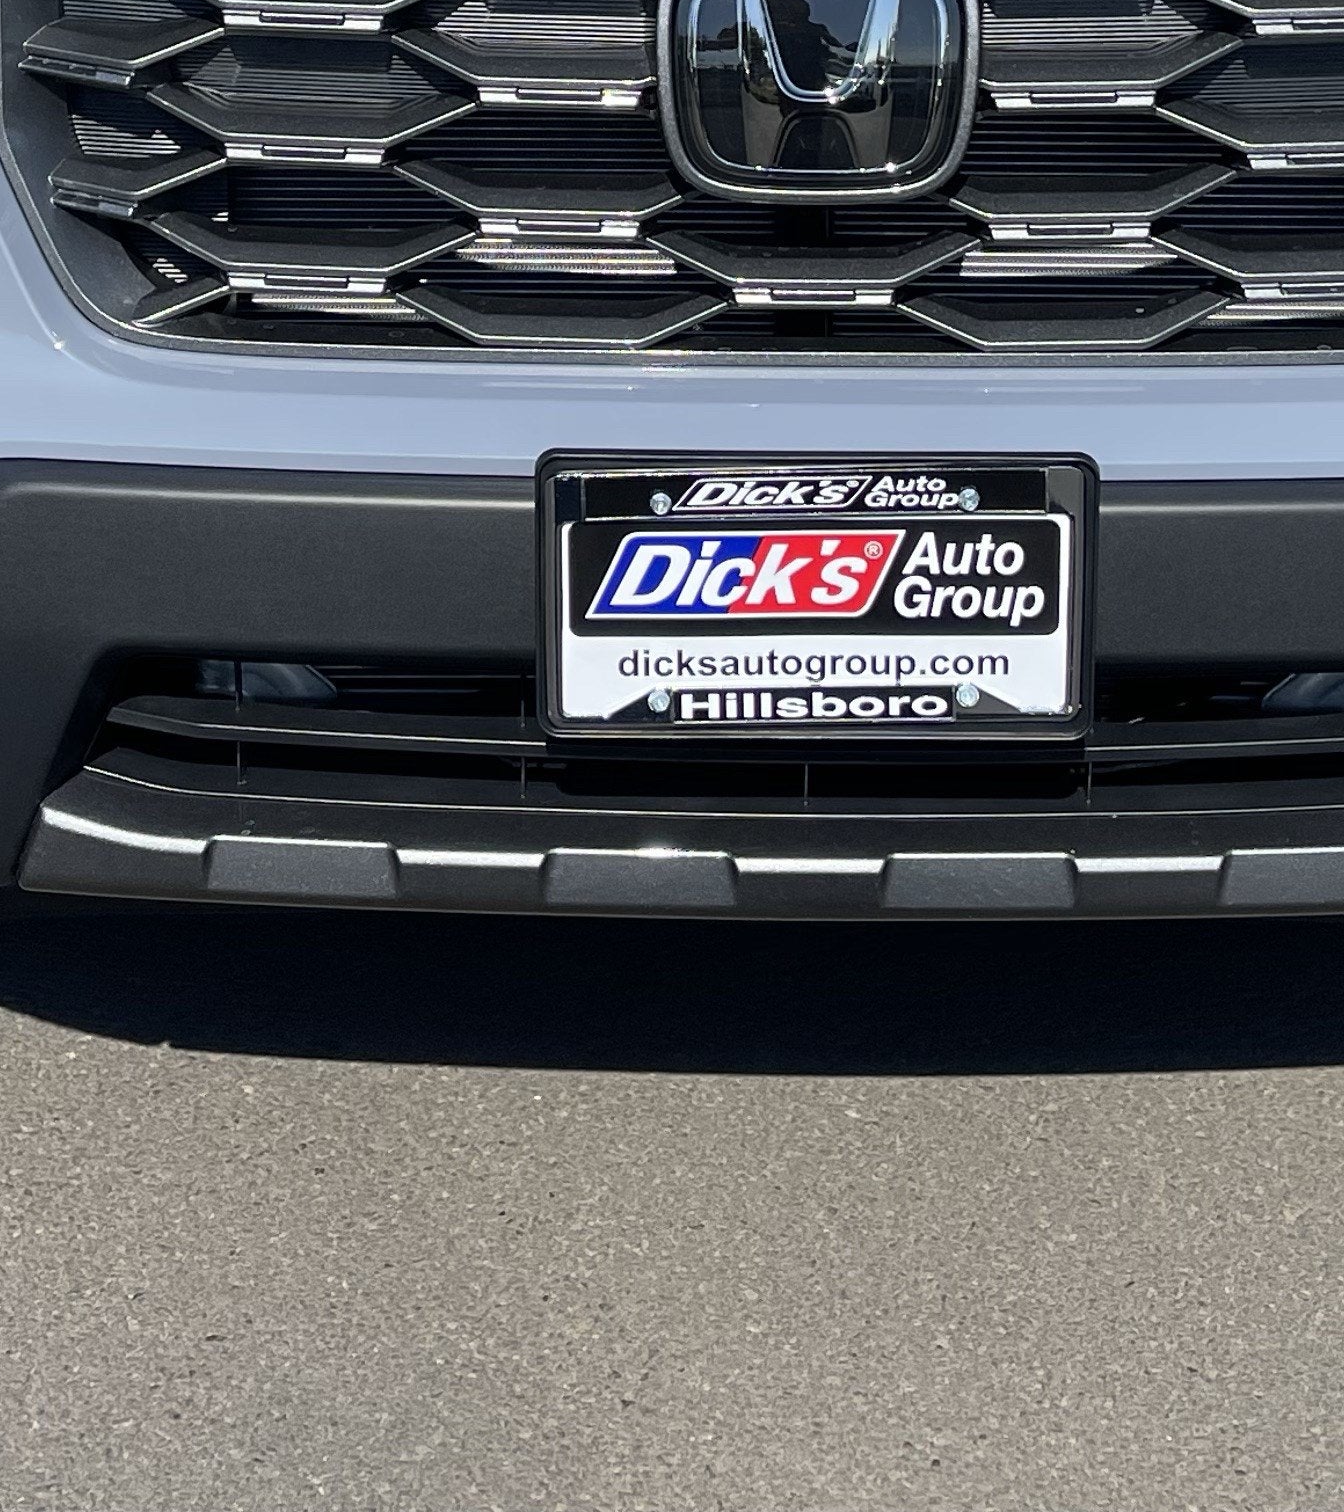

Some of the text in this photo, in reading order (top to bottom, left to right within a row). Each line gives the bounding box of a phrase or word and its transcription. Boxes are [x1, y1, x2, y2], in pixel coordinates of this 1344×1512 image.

[871, 475, 947, 492] Auto
[864, 491, 960, 509] Group
[901, 531, 1025, 575] Auto
[893, 575, 1046, 627] Group
[617, 648, 1010, 683] dicksautogroup.com
[679, 692, 949, 720] Hillsboro
